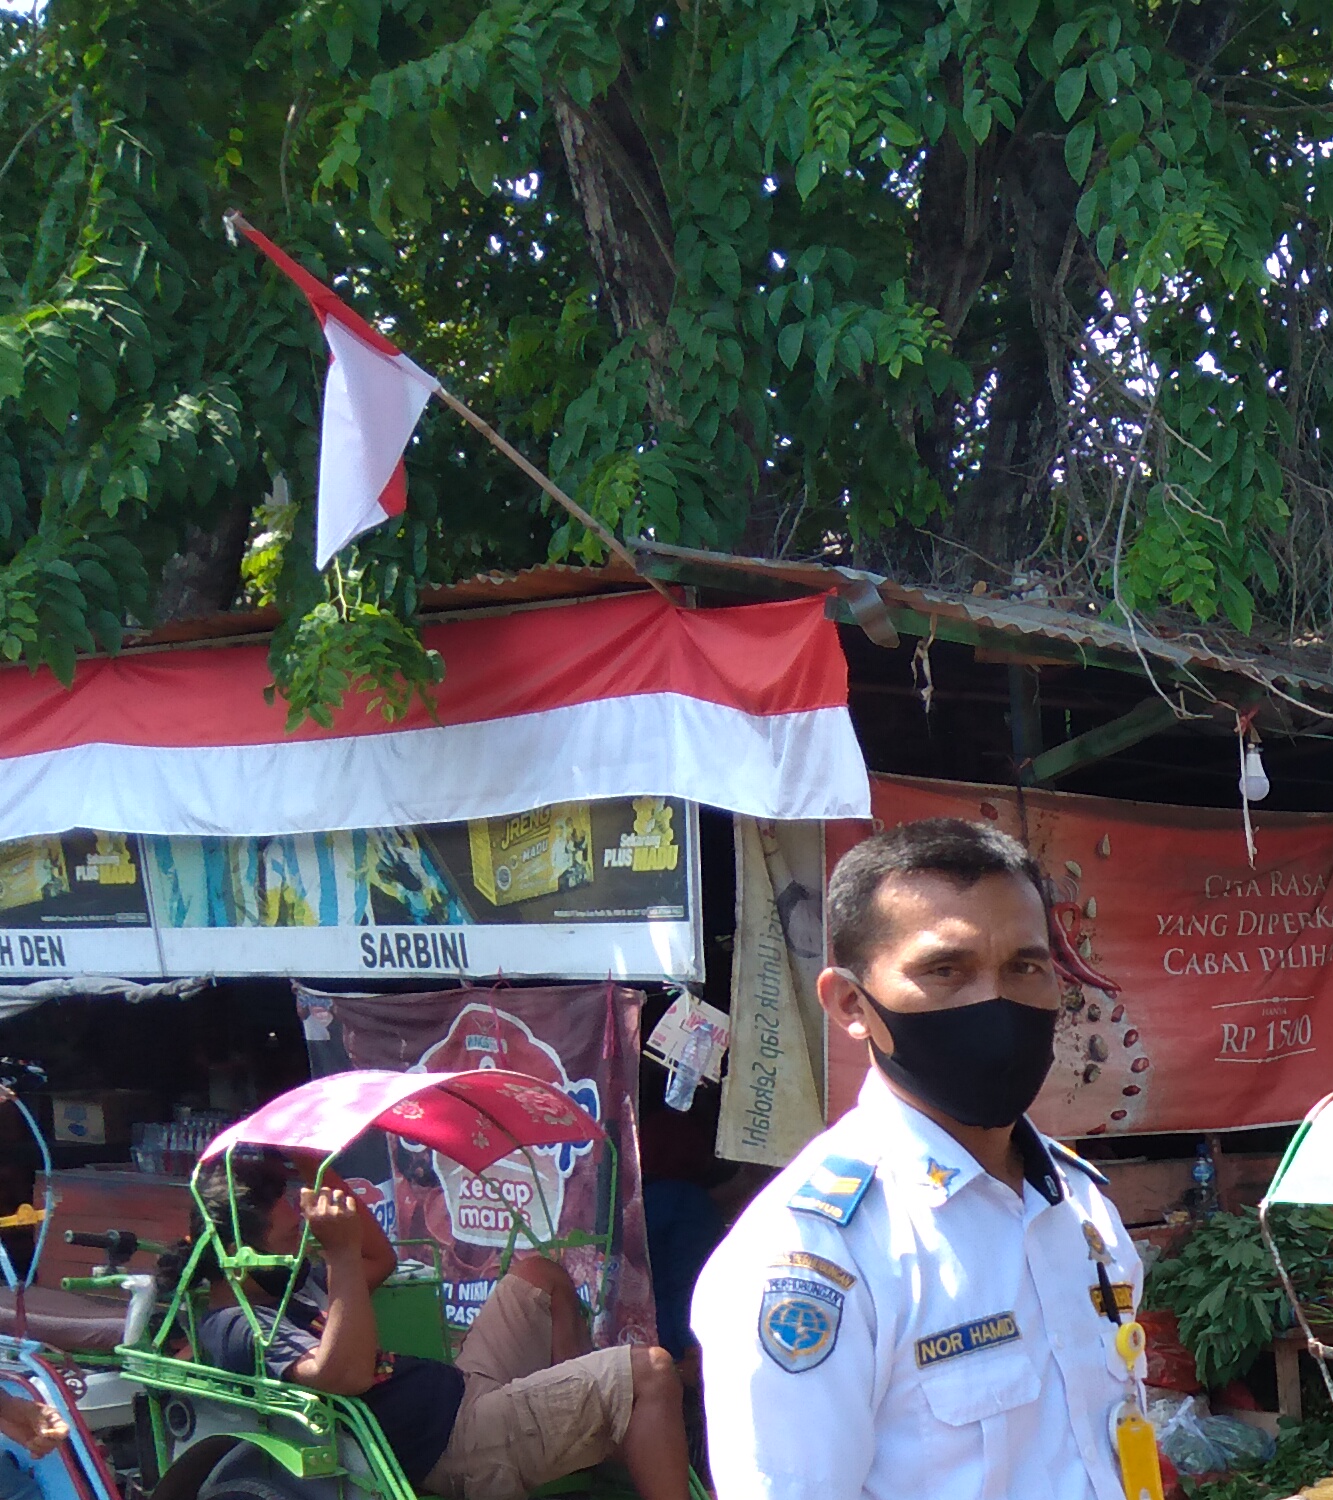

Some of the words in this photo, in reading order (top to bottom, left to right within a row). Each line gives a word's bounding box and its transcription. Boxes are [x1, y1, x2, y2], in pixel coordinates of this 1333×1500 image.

[603, 848, 633, 868] PLUS
[632, 845, 679, 872] MADU
[1270, 870, 1328, 897] RASA
[1156, 914, 1228, 937] YANG
[21, 935, 66, 967] DEN
[360, 933, 469, 969] SARBINI
[1163, 947, 1251, 976] CABAI
[1220, 1022, 1256, 1053] RP
[1265, 1014, 1313, 1052] 1500
[458, 1176, 533, 1208] kecap
[919, 1332, 964, 1361] NOR
[969, 1315, 1017, 1347] HAMID
